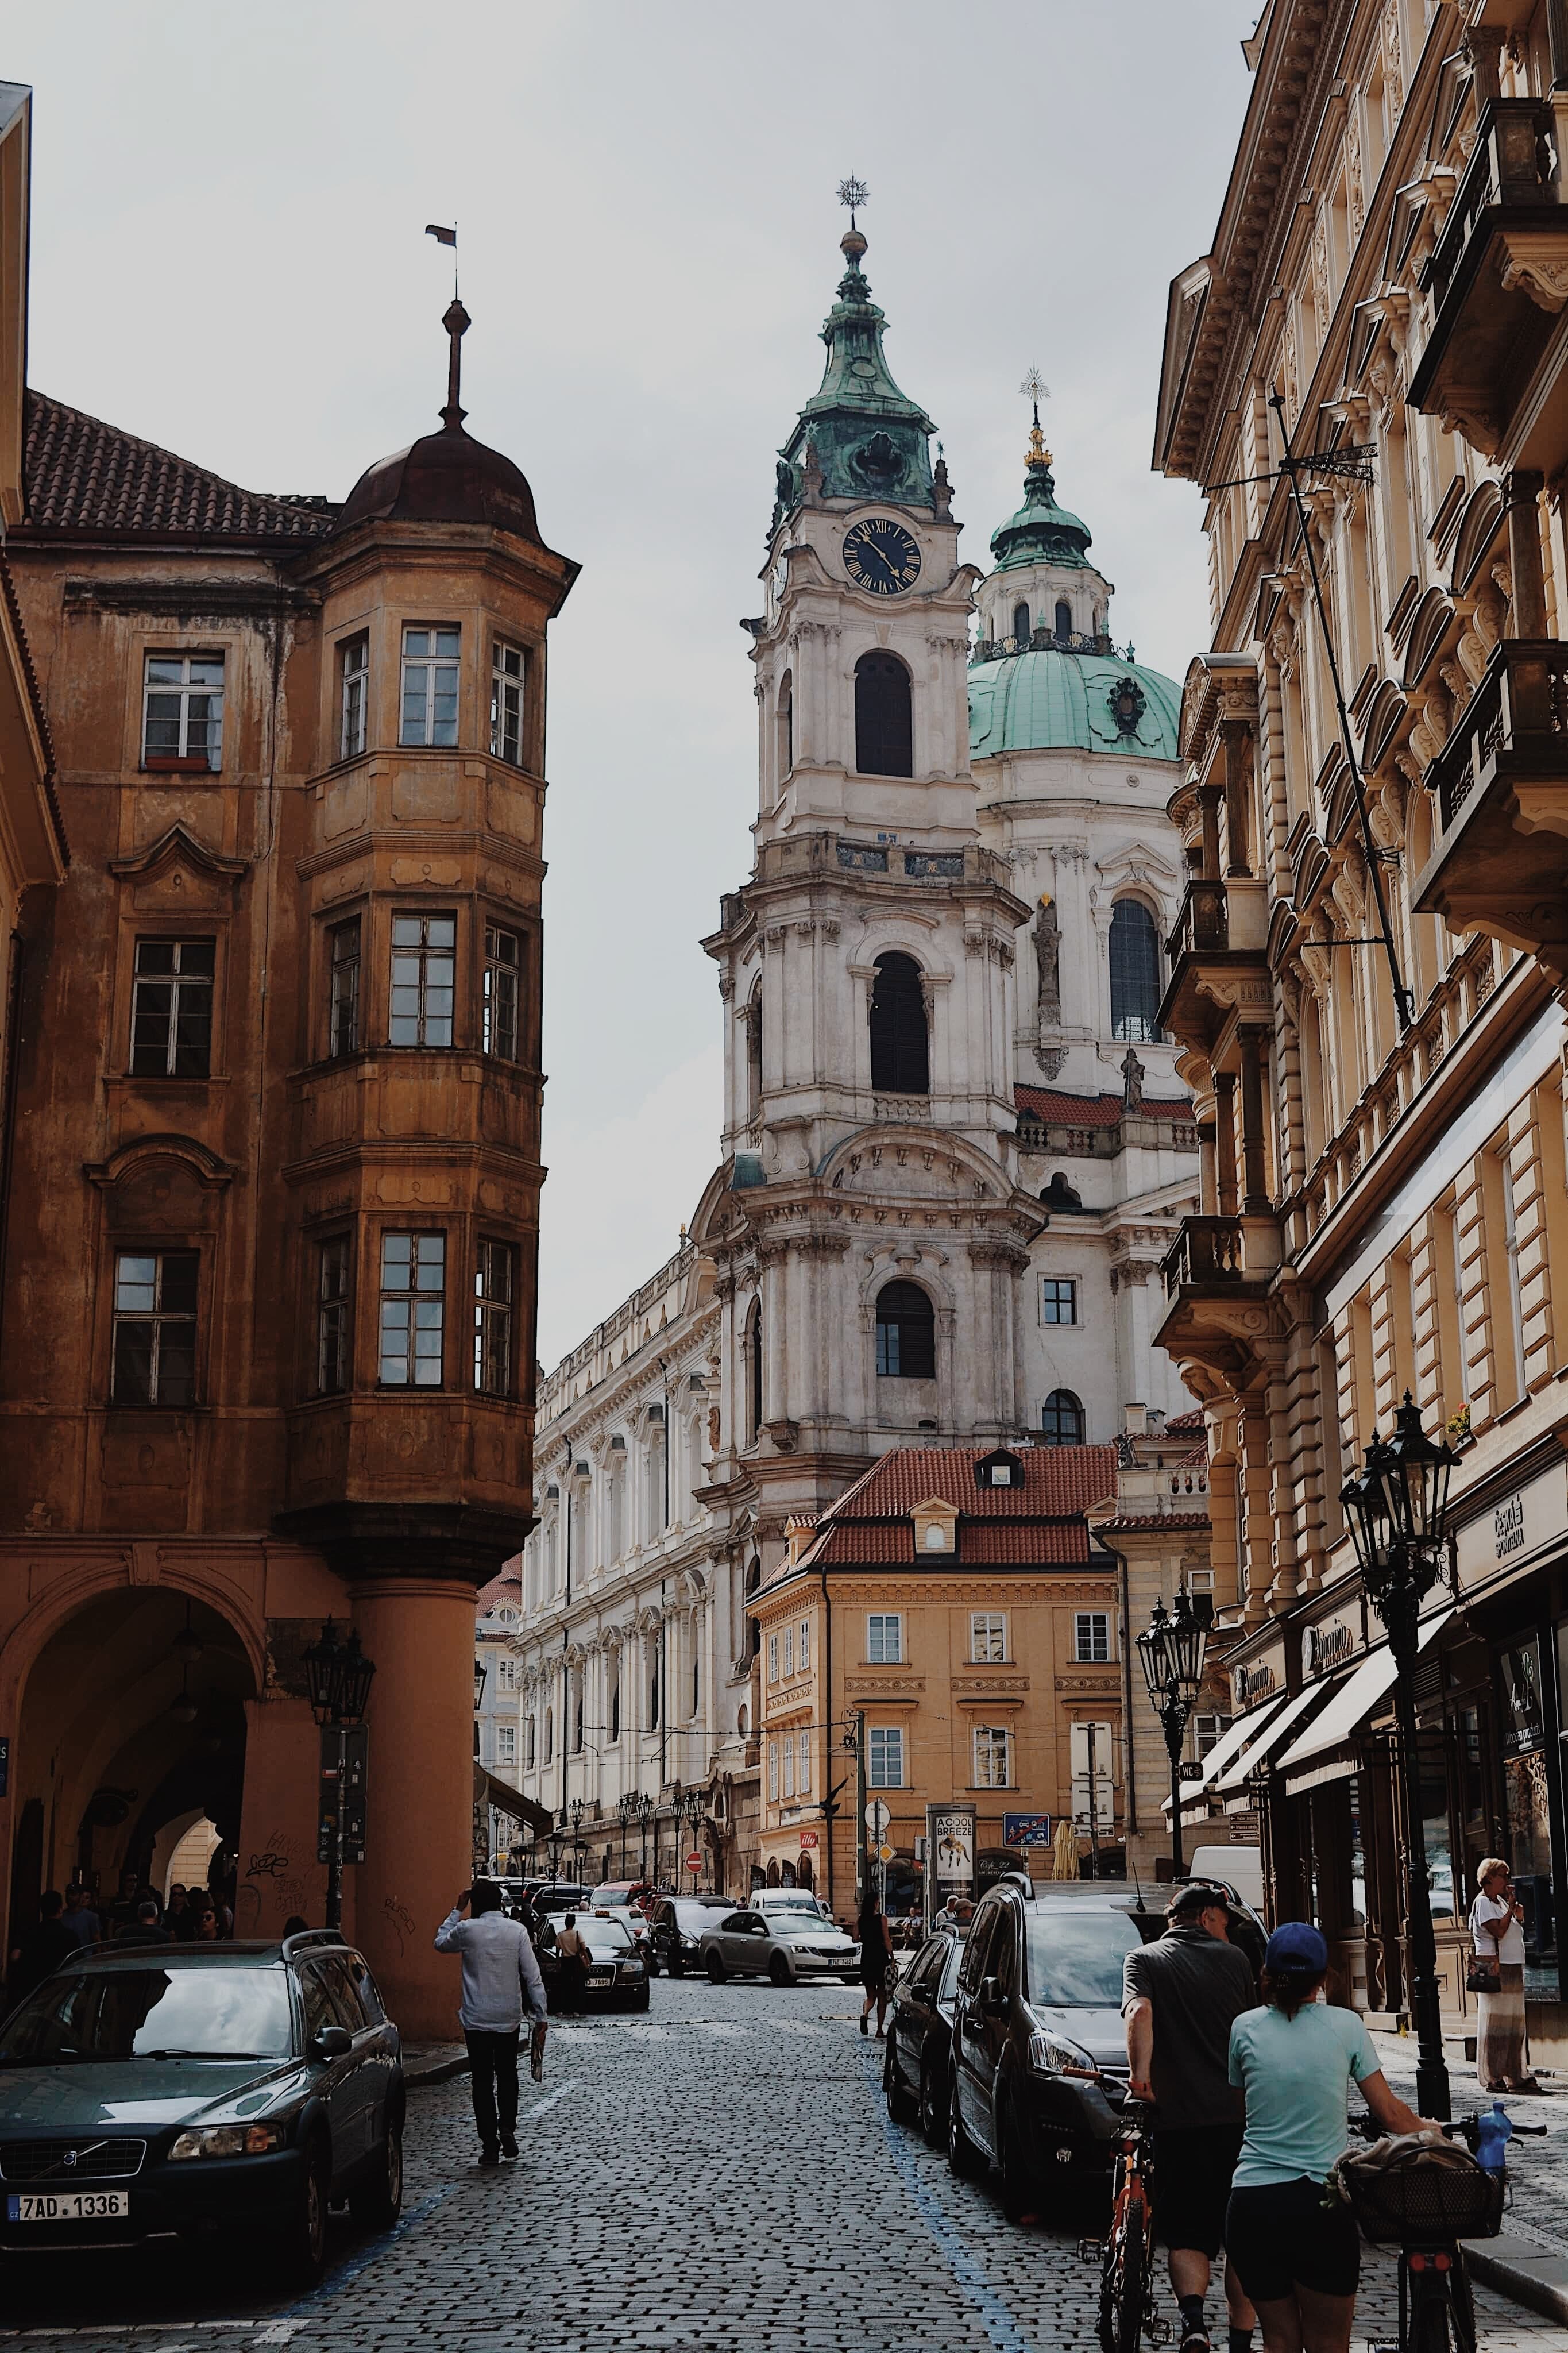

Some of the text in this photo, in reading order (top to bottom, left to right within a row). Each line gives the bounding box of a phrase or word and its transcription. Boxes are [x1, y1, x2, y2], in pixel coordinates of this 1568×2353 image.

[875, 520, 887, 533] XII
[893, 527, 901, 538] I
[848, 533, 861, 545] X
[902, 540, 916, 549] II
[906, 556, 920, 565] III
[879, 580, 888, 593] VI
[1183, 1766, 1193, 1777] WC
[937, 1827, 972, 1835] BREEZE
[801, 1834, 815, 1847] illy
[24, 2195, 119, 2218] 7AD 1336
